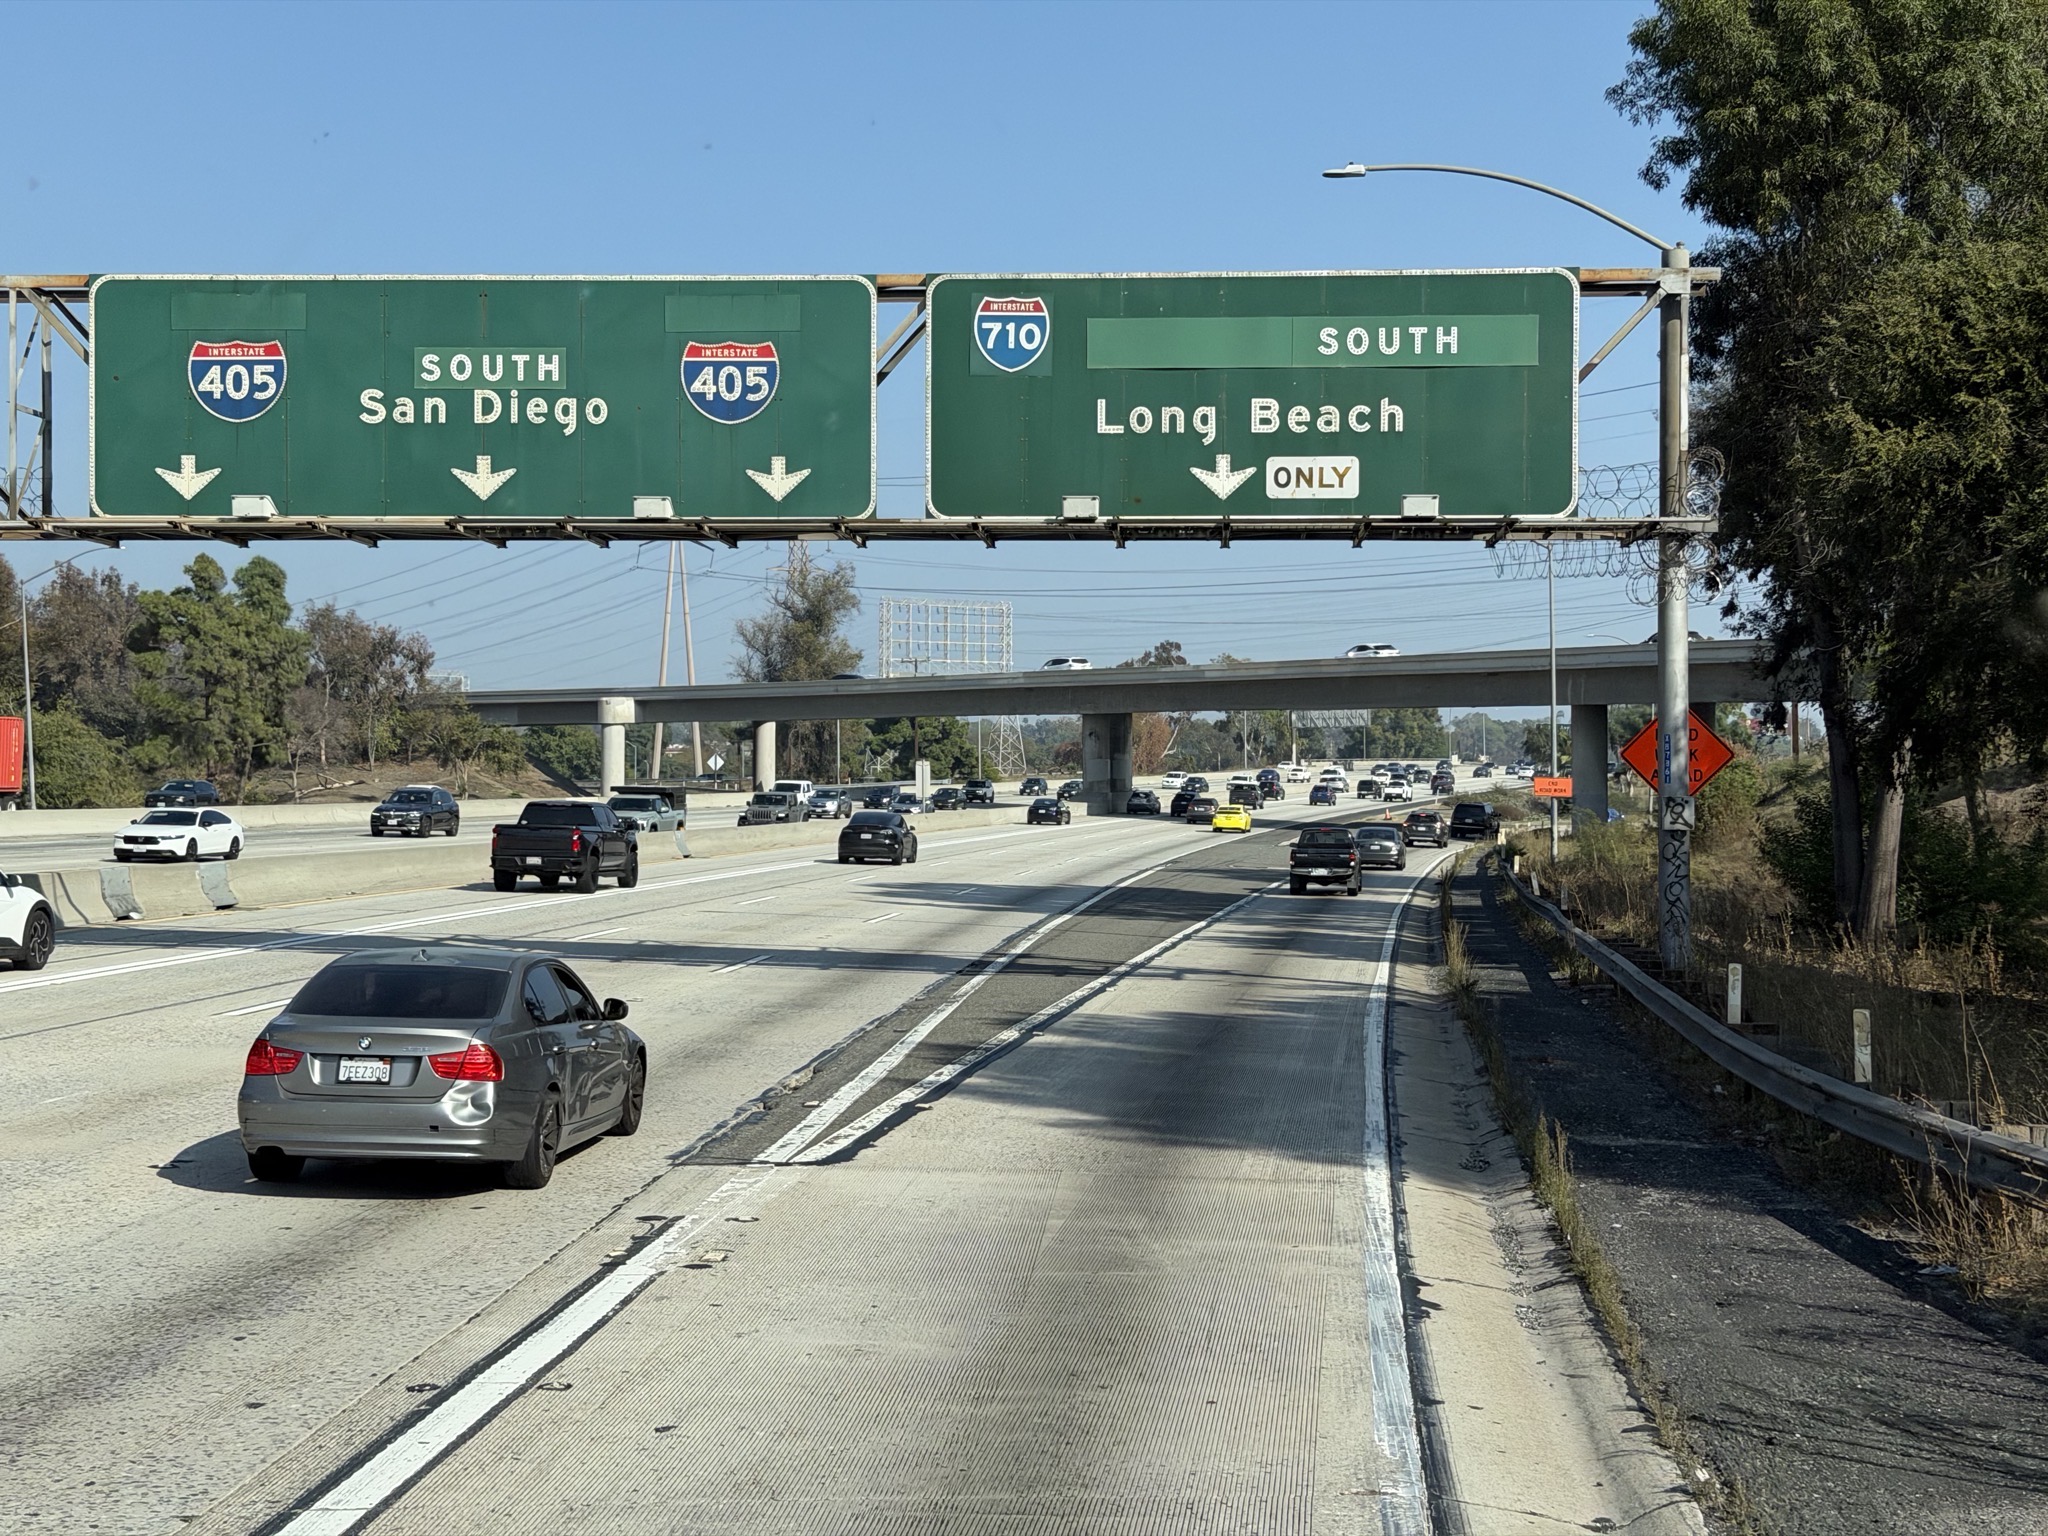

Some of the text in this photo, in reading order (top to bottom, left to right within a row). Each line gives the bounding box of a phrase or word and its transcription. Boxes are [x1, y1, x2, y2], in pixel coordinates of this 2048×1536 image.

[990, 302, 1035, 311] INTERSTATE
[981, 322, 1041, 350] 710
[1317, 326, 1458, 355] SOUTH
[208, 347, 266, 356] INTERSTATE
[701, 348, 759, 357] INTERSTATE
[420, 353, 560, 382] SOUTH
[197, 364, 277, 400] 405
[690, 365, 770, 401] 405
[358, 388, 609, 437] San Diego
[1096, 397, 1405, 446] Long Beach
[1272, 466, 1352, 490] ONLY
[342, 1065, 388, 1079] 7EEZ308
